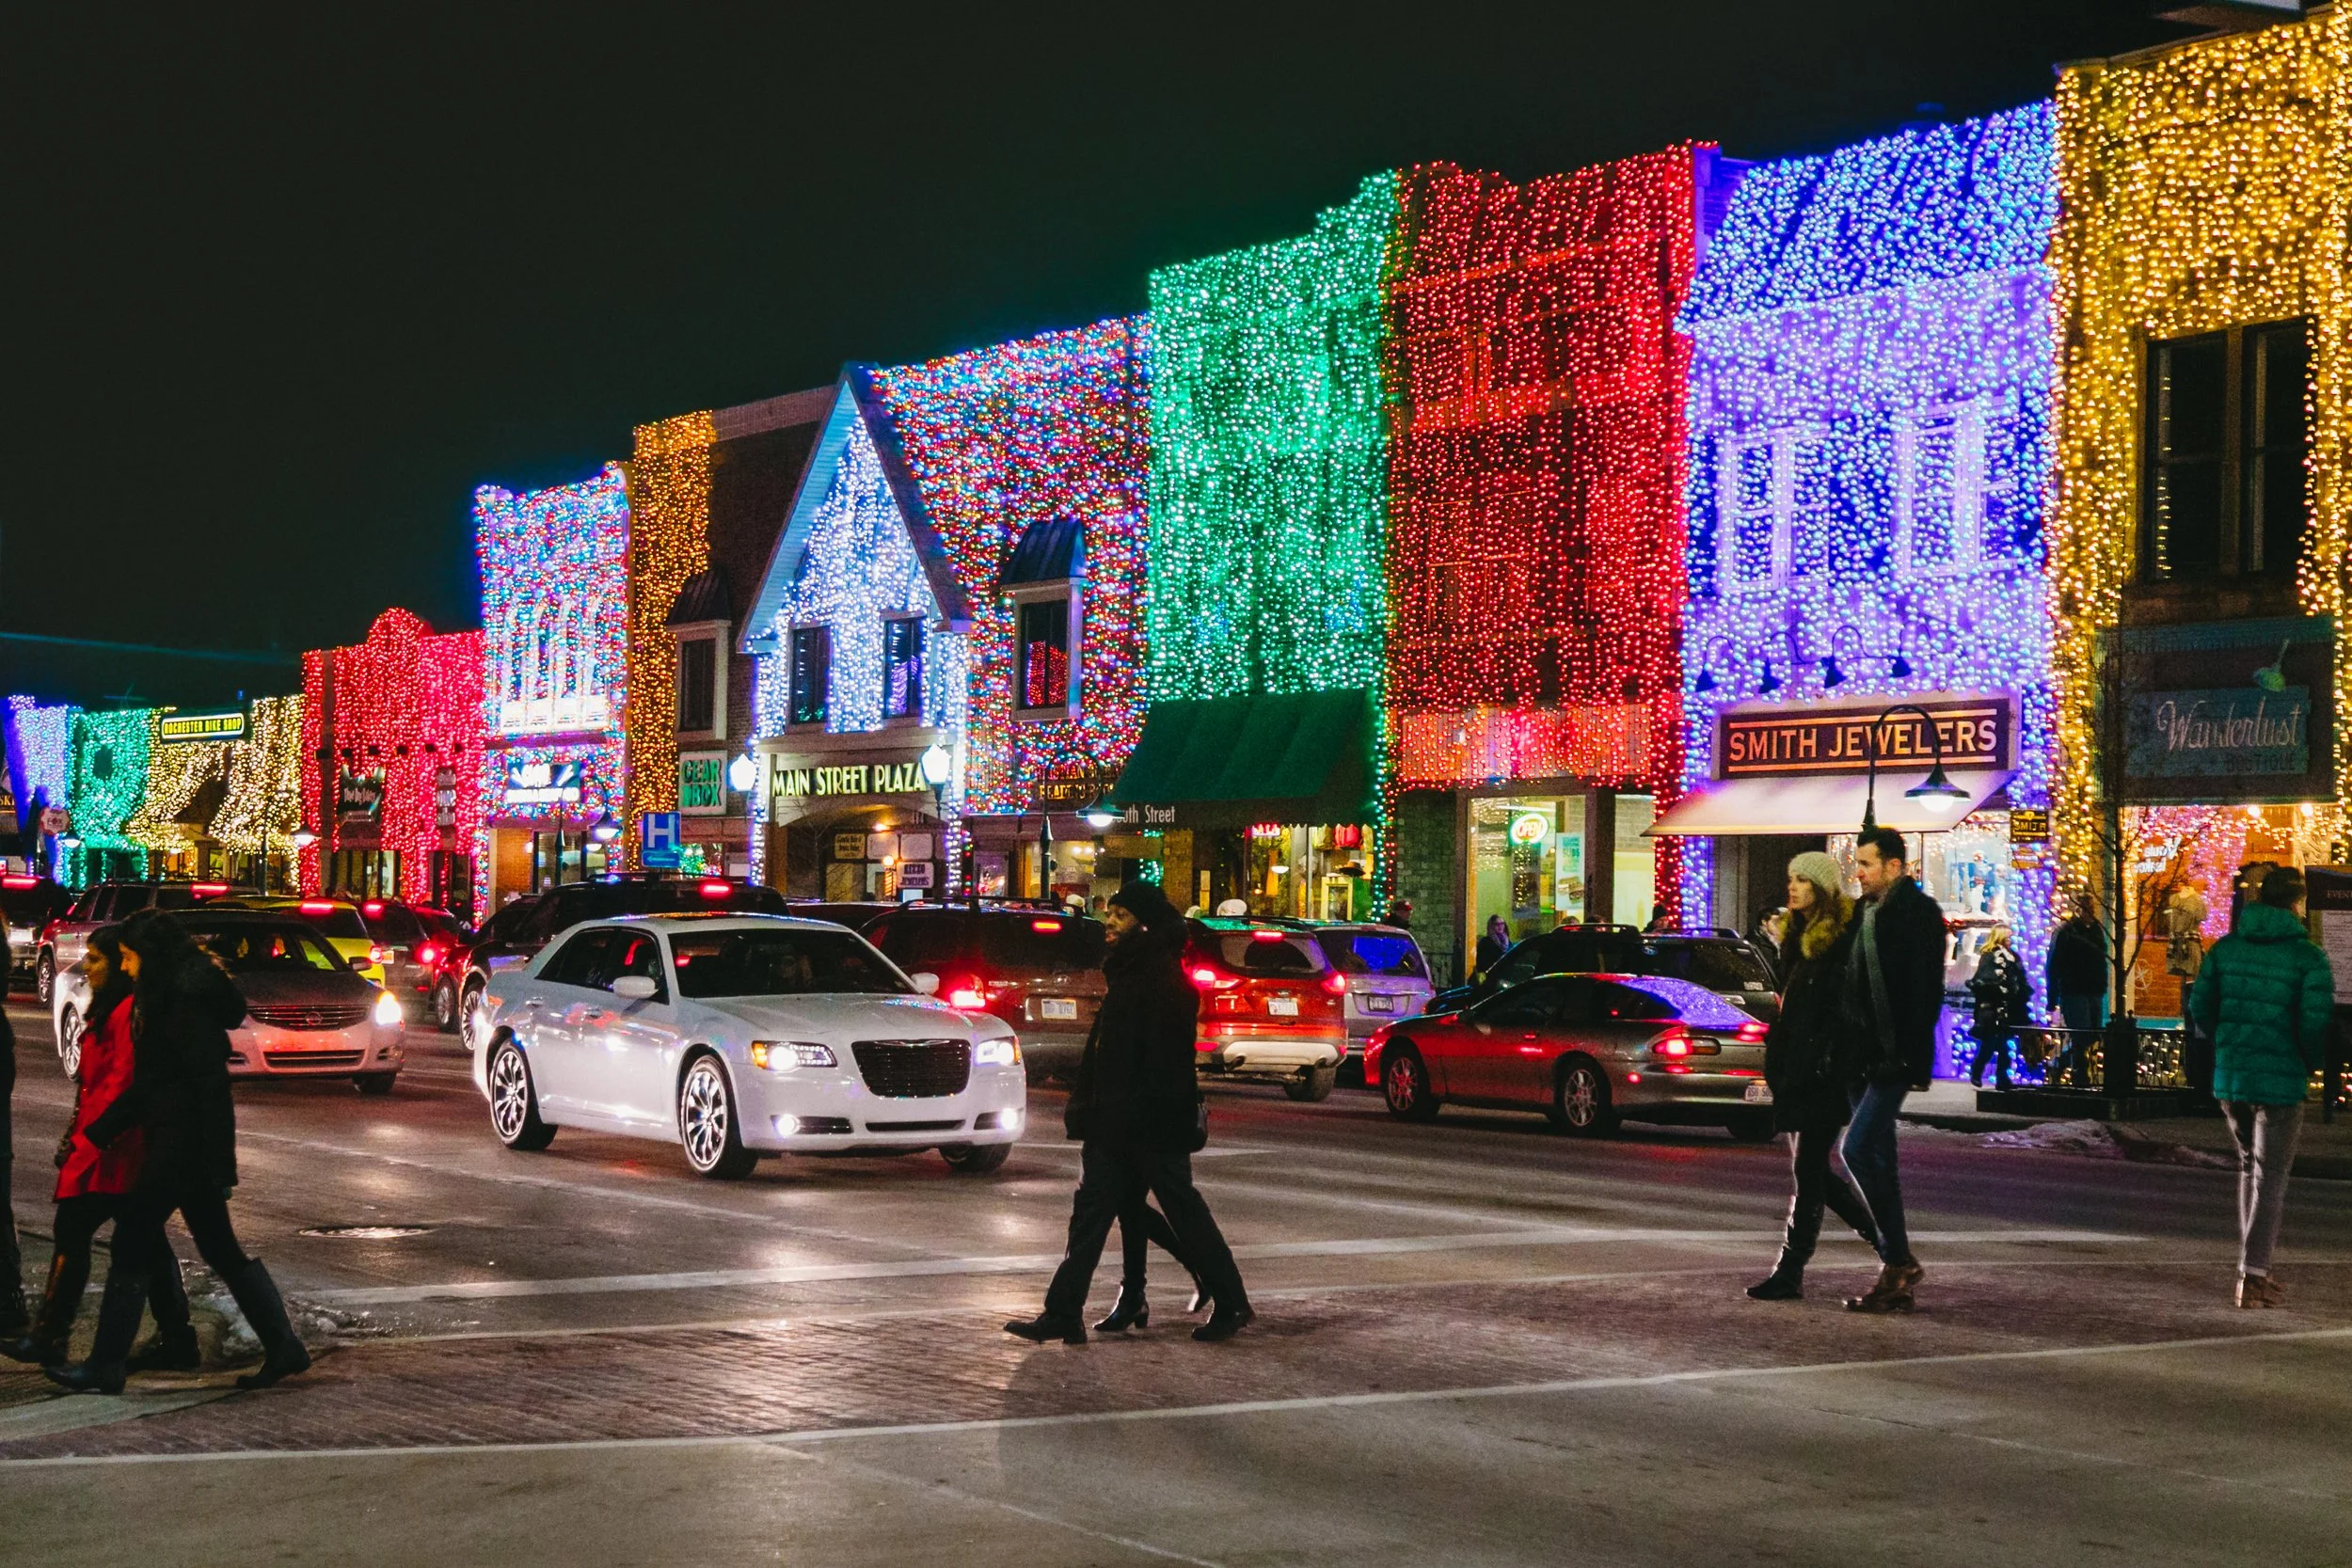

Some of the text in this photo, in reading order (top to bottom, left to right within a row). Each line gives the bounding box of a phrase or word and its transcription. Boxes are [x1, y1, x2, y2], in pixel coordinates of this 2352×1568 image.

[164, 718, 242, 735] ROCHESTER BIKE SHOP
[2156, 696, 2302, 752] Wanderlust
[1728, 719, 1997, 762] SMITH JEWELERS
[681, 758, 723, 784] GEAR
[771, 763, 927, 798] MAIN STREET PLAZA
[1144, 804, 1176, 824] Street
[647, 814, 676, 848] H
[1516, 820, 1544, 839] OPEN
